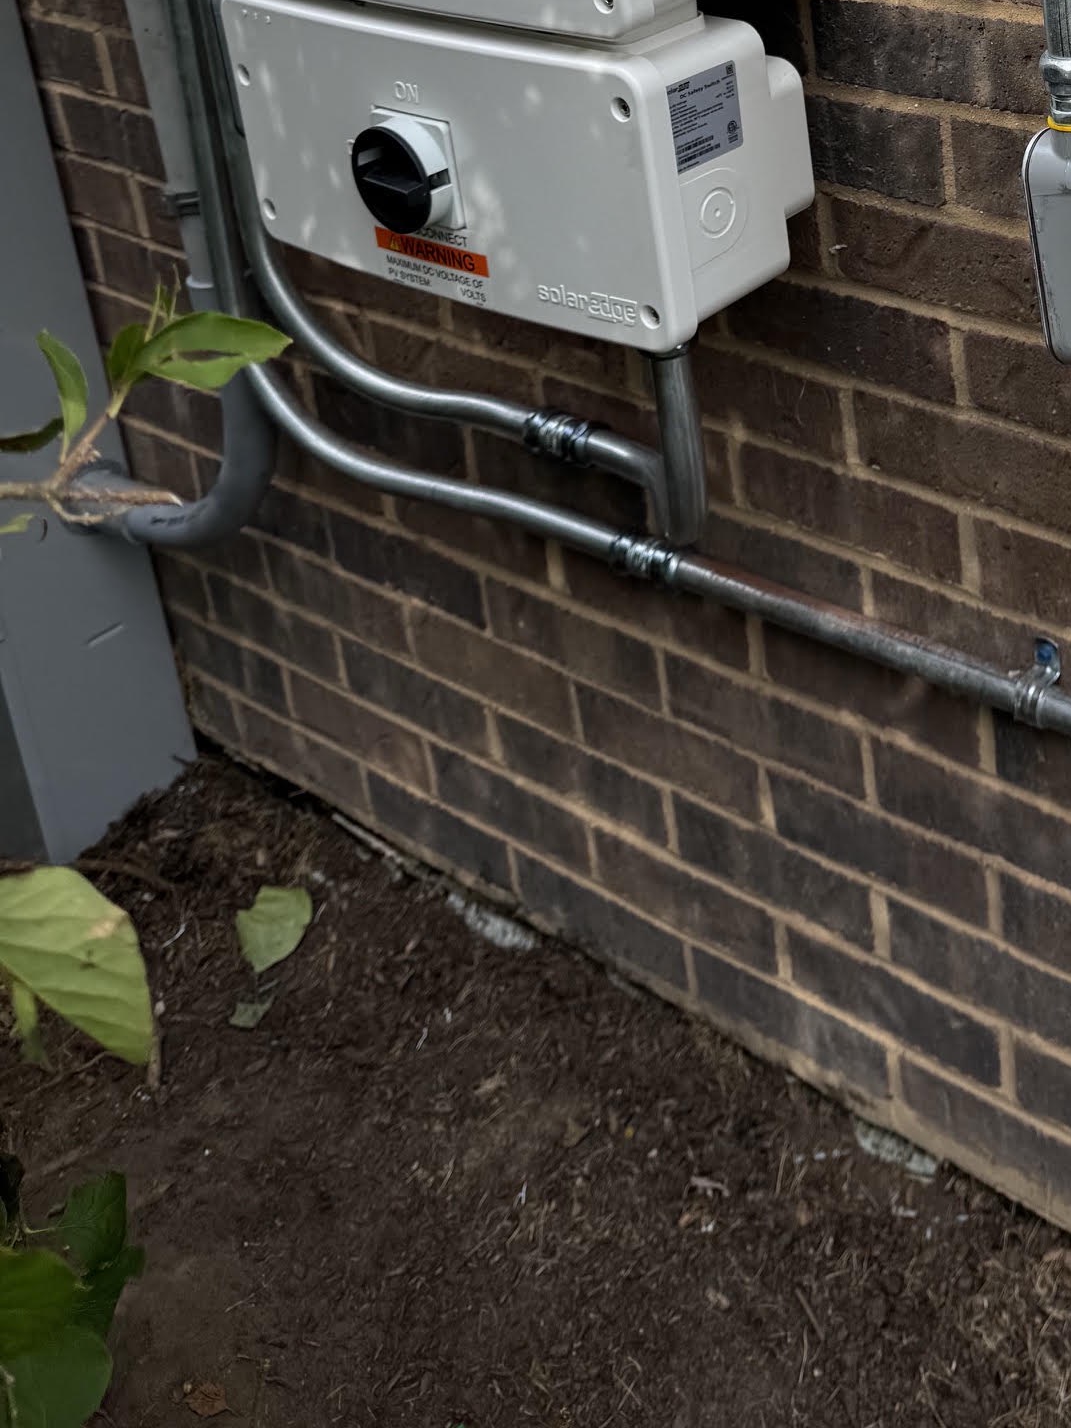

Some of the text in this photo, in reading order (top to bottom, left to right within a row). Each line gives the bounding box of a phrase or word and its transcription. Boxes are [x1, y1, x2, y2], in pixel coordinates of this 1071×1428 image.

[393, 80, 420, 104] ON
[400, 236, 475, 271] WARNING
[386, 254, 483, 289] MAXIMUM DC VOLTAGE OF
[460, 287, 487, 302] VOLTS
[538, 284, 637, 327] solaredge
